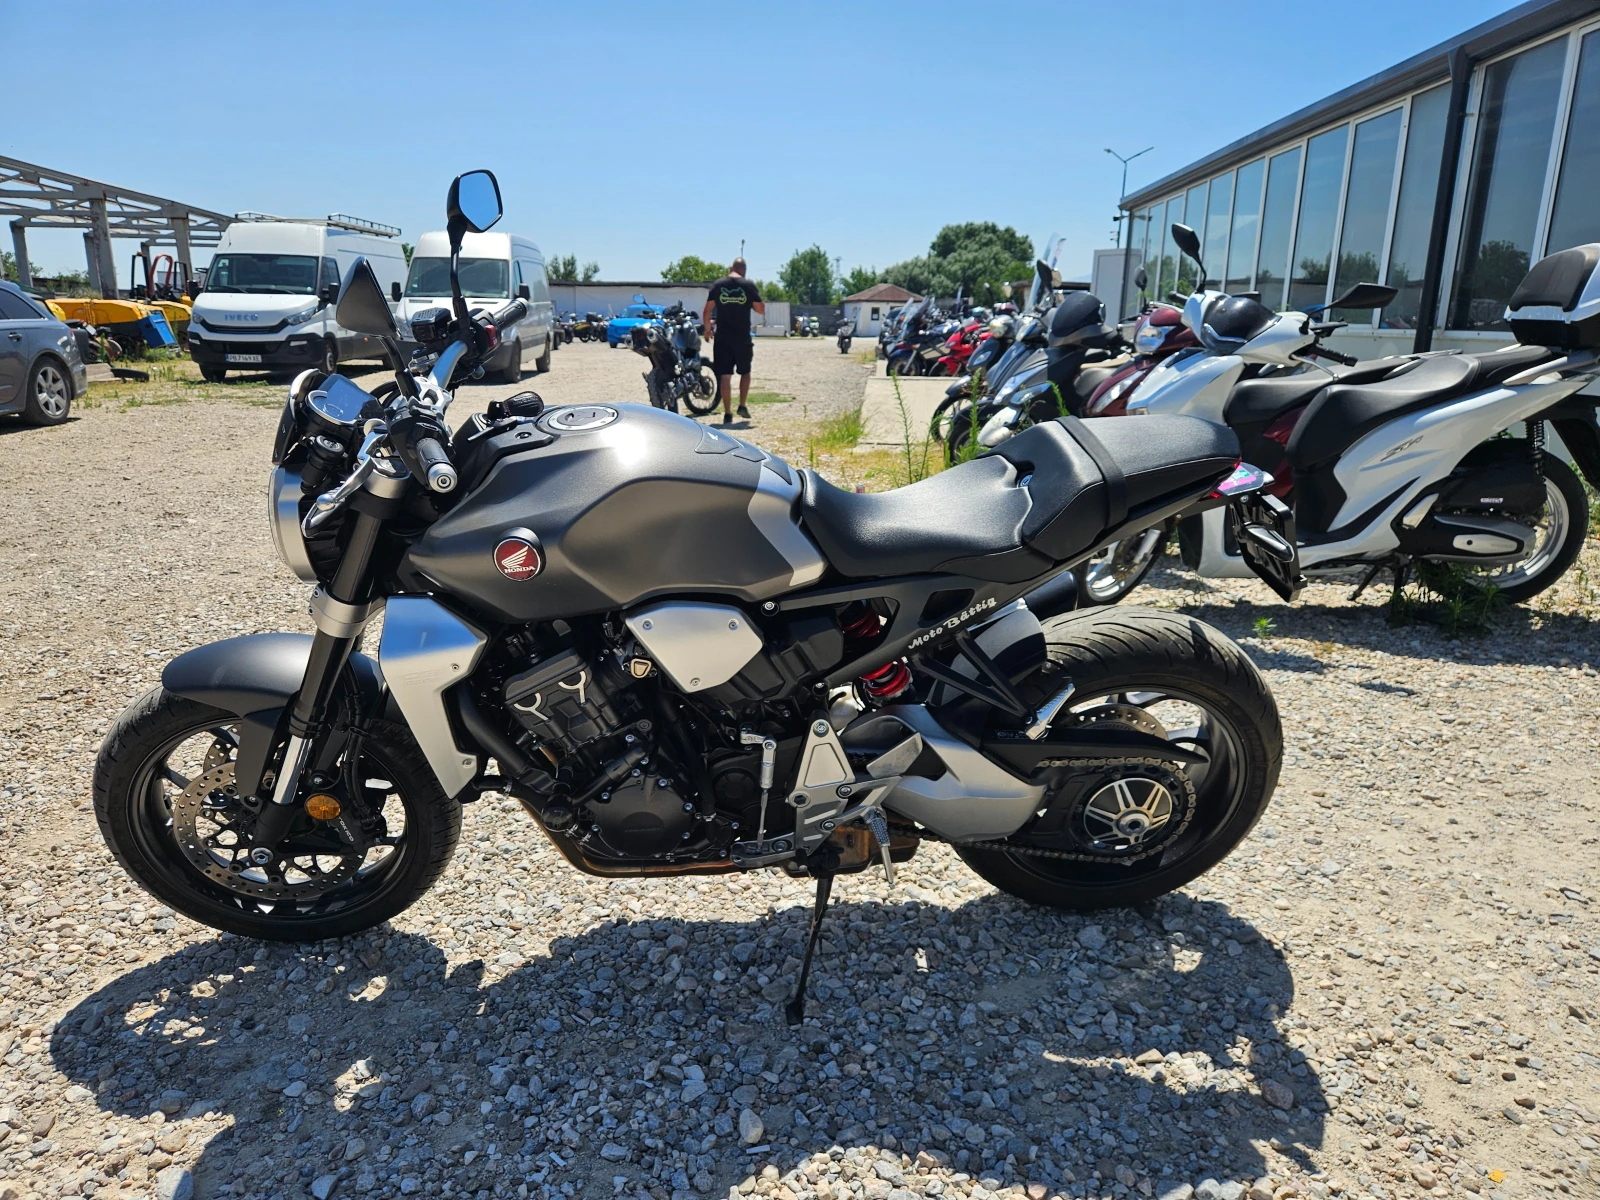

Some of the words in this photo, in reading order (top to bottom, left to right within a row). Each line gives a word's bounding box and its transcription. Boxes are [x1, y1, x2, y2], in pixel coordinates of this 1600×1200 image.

[224, 313, 259, 321] IVECO
[503, 565, 536, 573] HONDA
[908, 626, 943, 649] Moto
